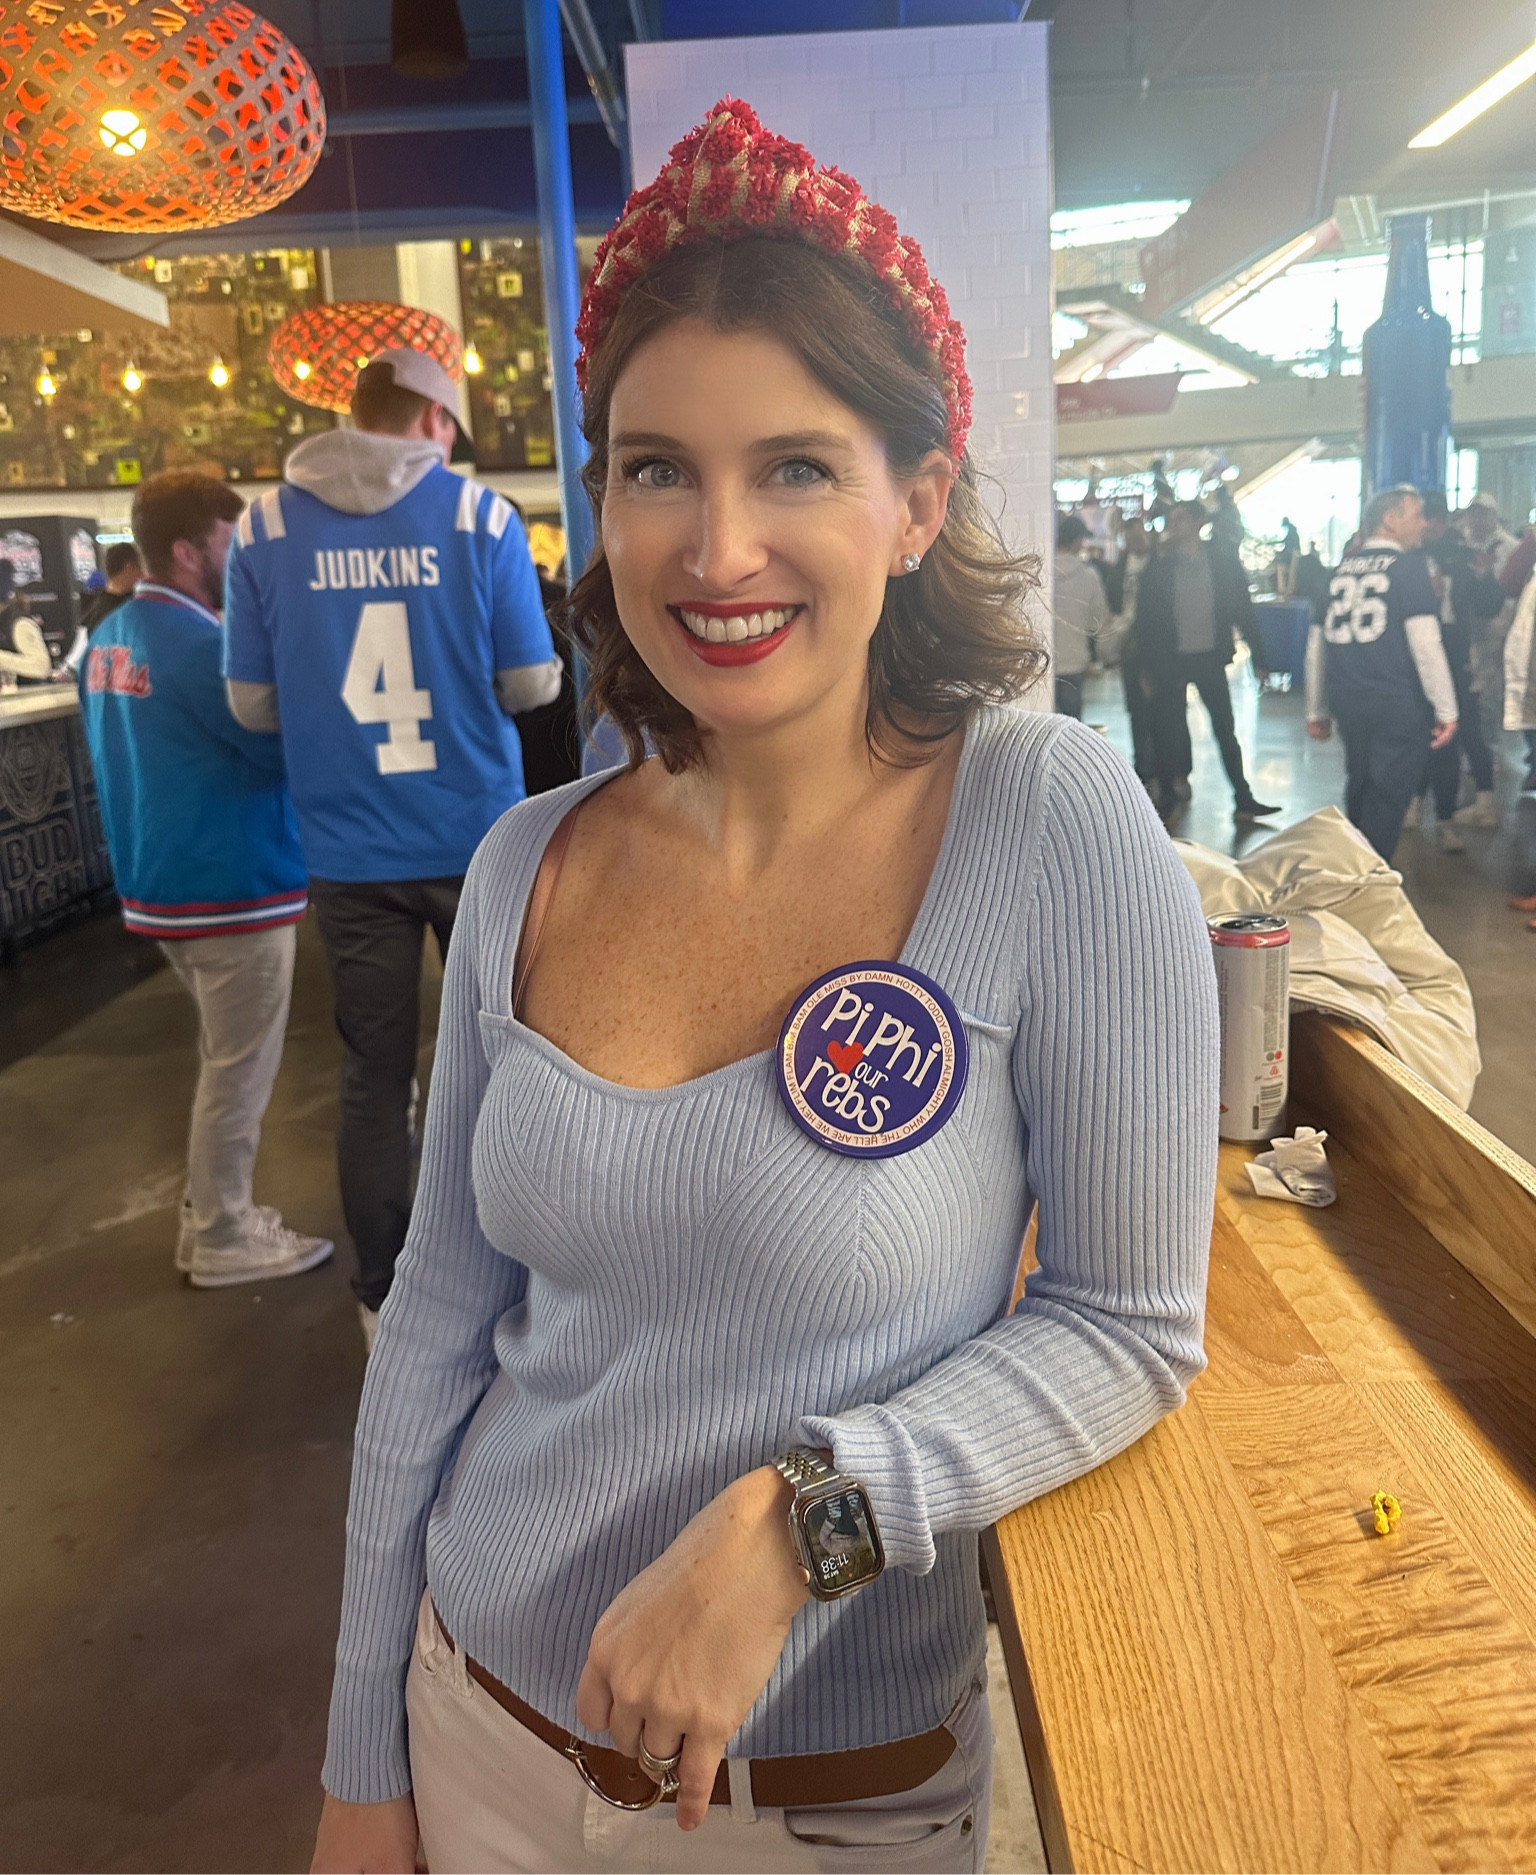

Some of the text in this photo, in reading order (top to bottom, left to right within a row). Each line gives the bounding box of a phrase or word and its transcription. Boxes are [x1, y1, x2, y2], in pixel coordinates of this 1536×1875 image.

[308, 545, 440, 591] JUDKINS
[1324, 572, 1390, 644] 26
[340, 601, 437, 775] 4
[1, 817, 77, 889] BUD
[0, 866, 88, 924] IGHT
[786, 972, 954, 1146] HOTTY TODDY GOSH ALMIGHTY WHO THE HELL ARE WE HEY FLIM FLAM BIM BAM OLE MISS BY DAMN
[821, 987, 942, 1088] Pi Phi
[801, 1056, 891, 1133] rebs
[854, 1061, 889, 1089] our
[821, 1552, 849, 1573] 11:38
